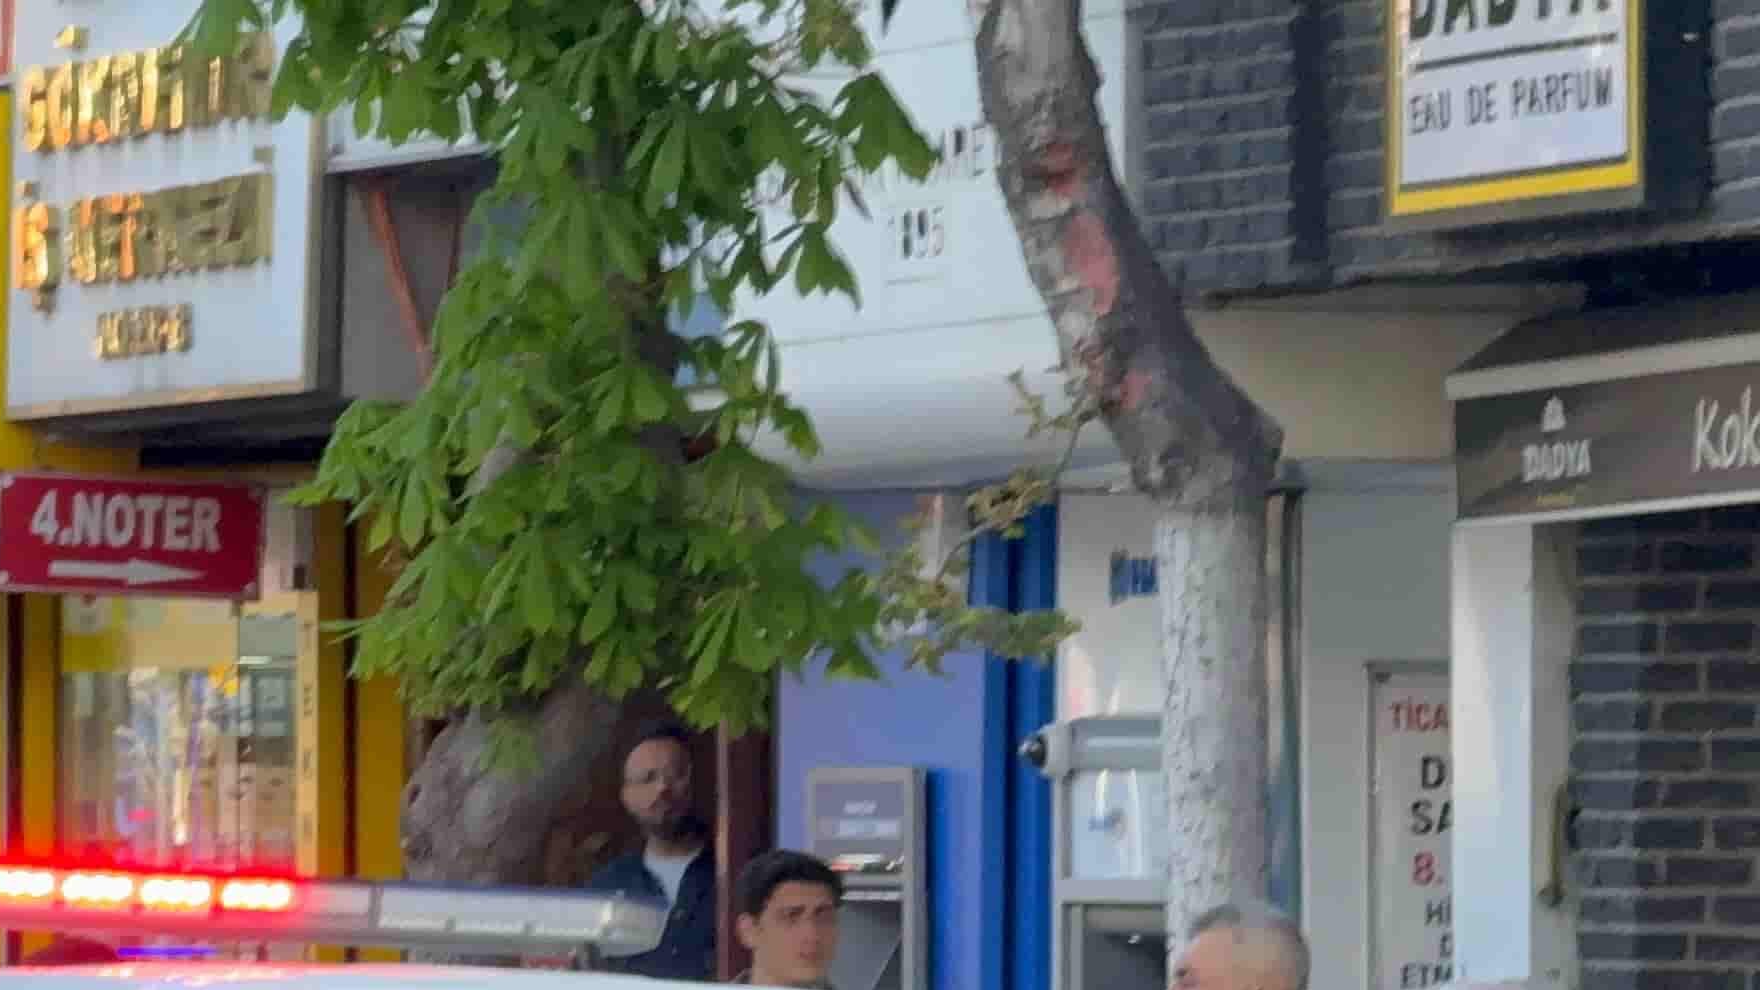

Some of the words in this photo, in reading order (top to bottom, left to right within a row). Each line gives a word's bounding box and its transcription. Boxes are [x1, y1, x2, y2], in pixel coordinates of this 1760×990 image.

[1408, 88, 1452, 134] EAU
[1466, 81, 1497, 127] DE
[1511, 66, 1613, 119] PARFUM
[1523, 438, 1590, 482] DADYA
[30, 489, 222, 551] 4.NOTER
